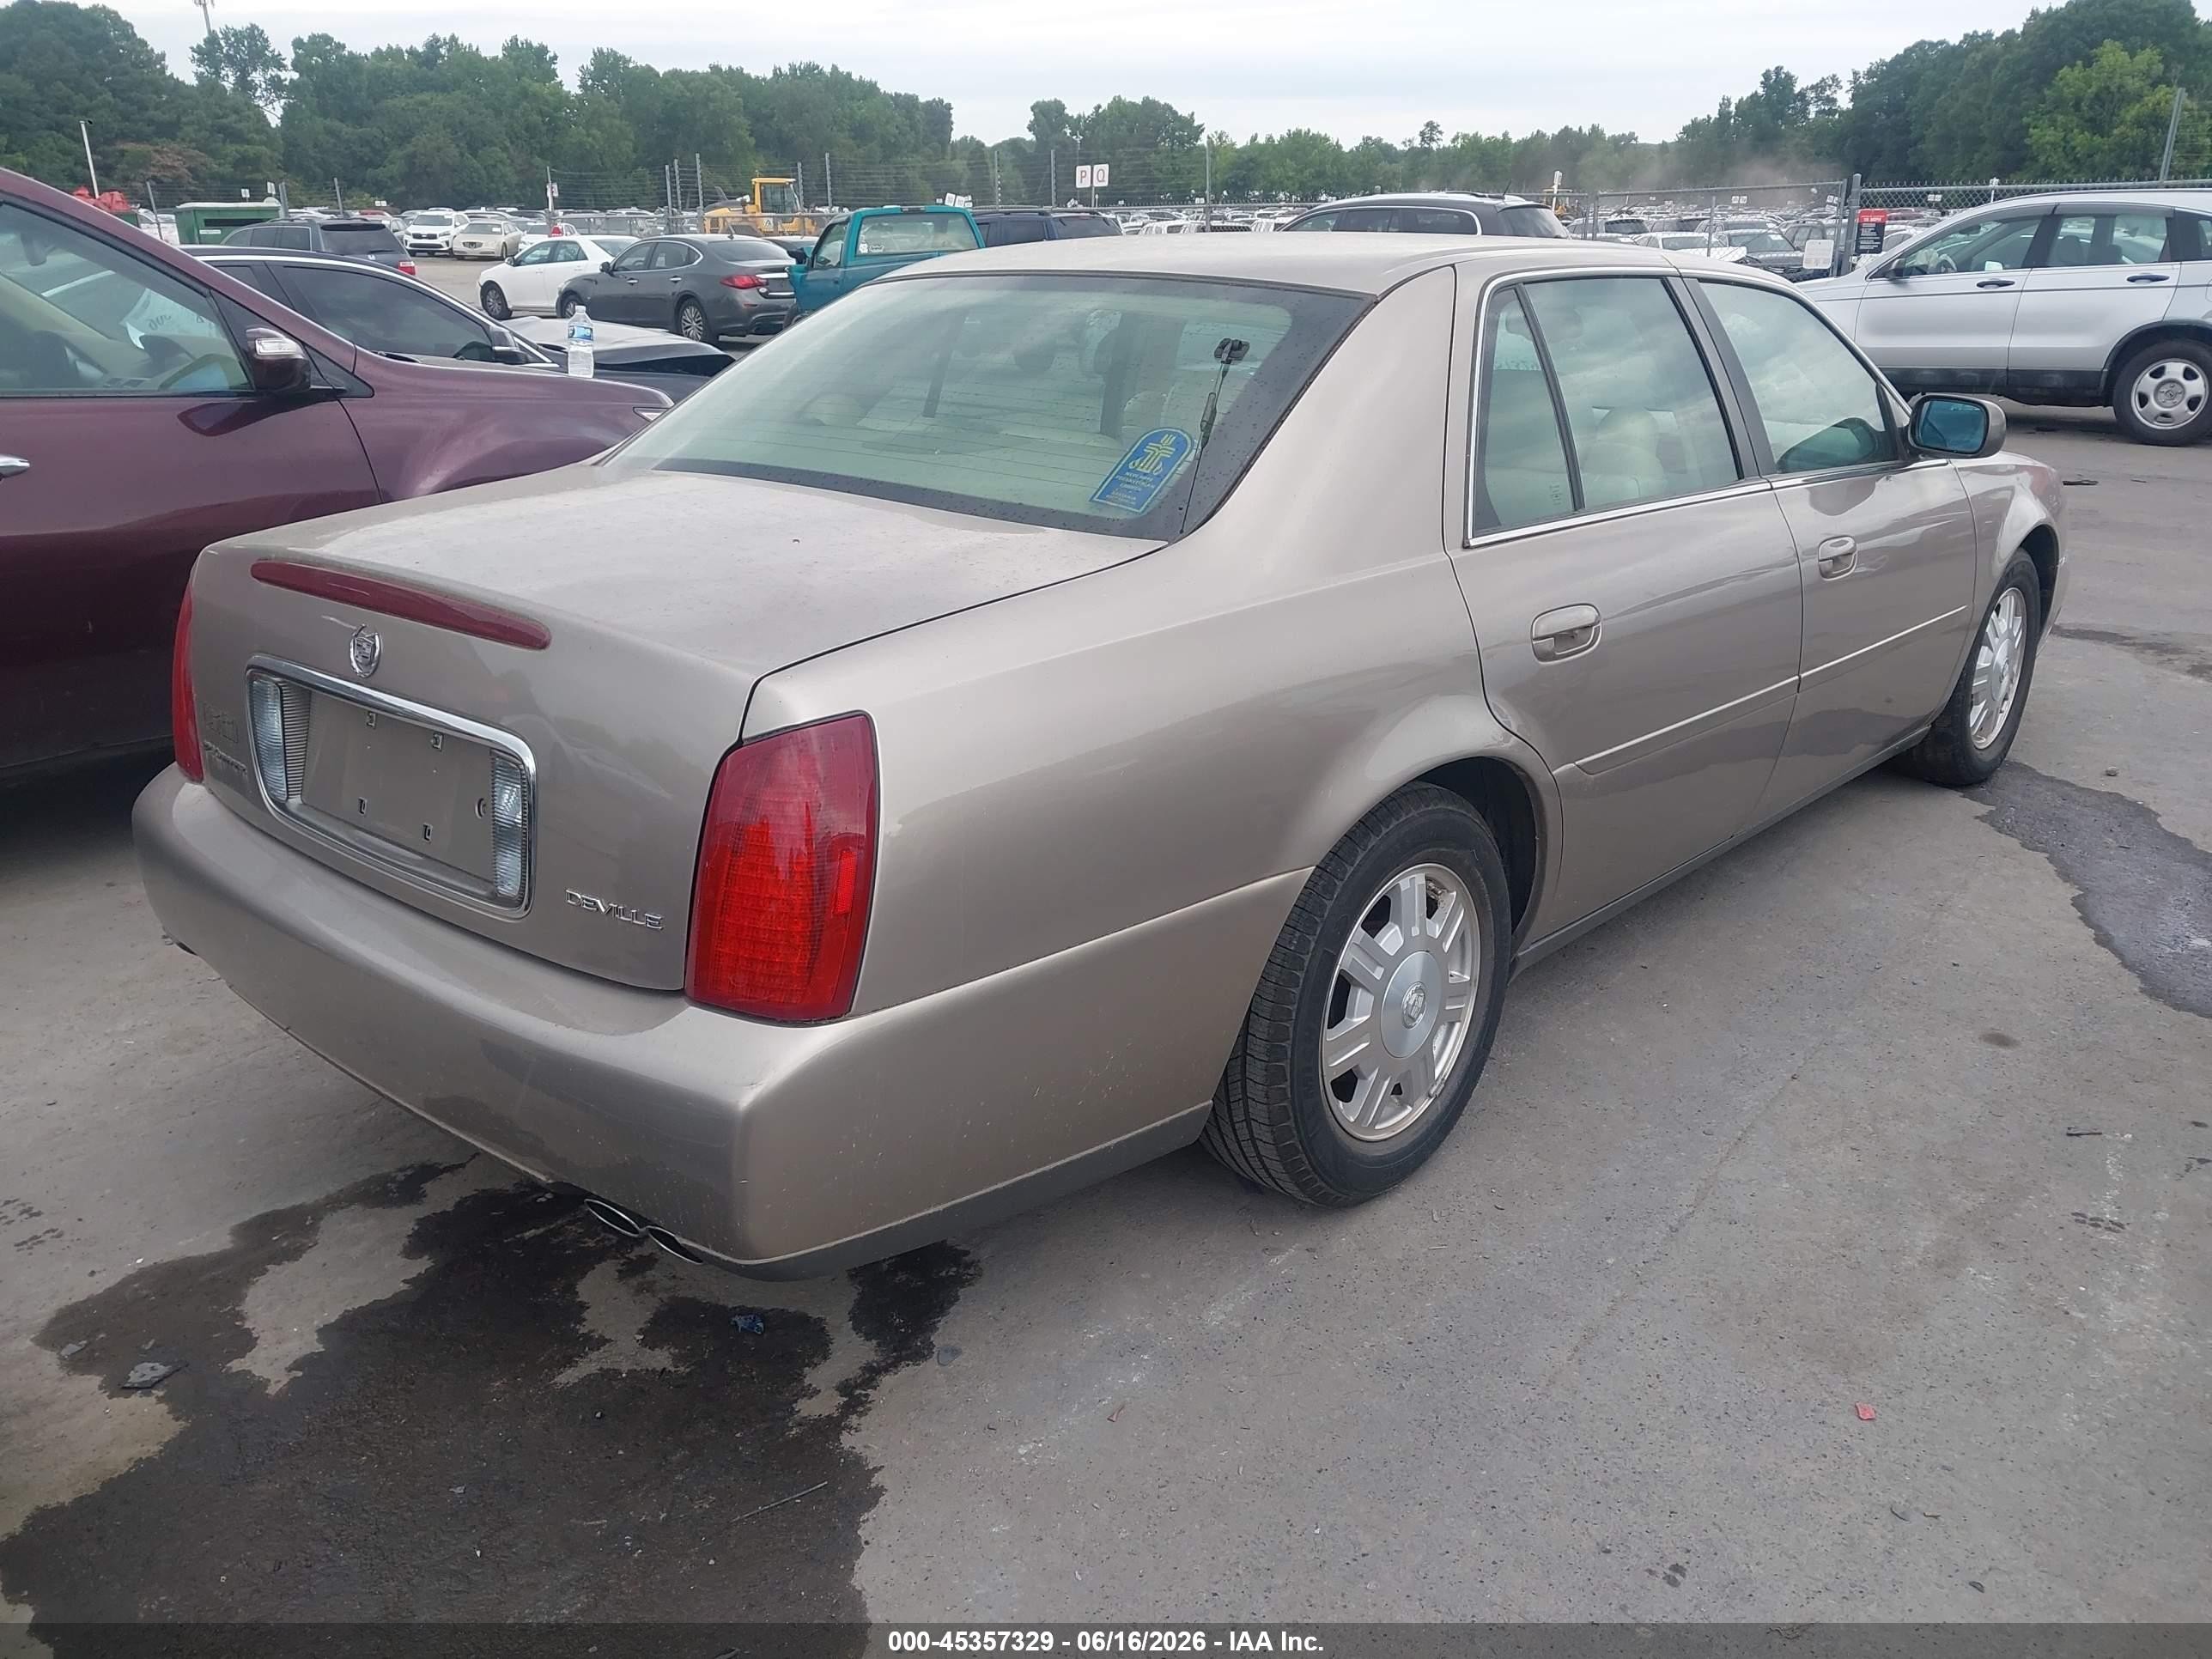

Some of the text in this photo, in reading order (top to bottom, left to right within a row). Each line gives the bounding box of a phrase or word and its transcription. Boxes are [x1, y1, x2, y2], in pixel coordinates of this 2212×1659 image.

[1079, 170, 1087, 184] P
[1097, 168, 1106, 183] Q
[565, 889, 665, 930] DEVILLE
